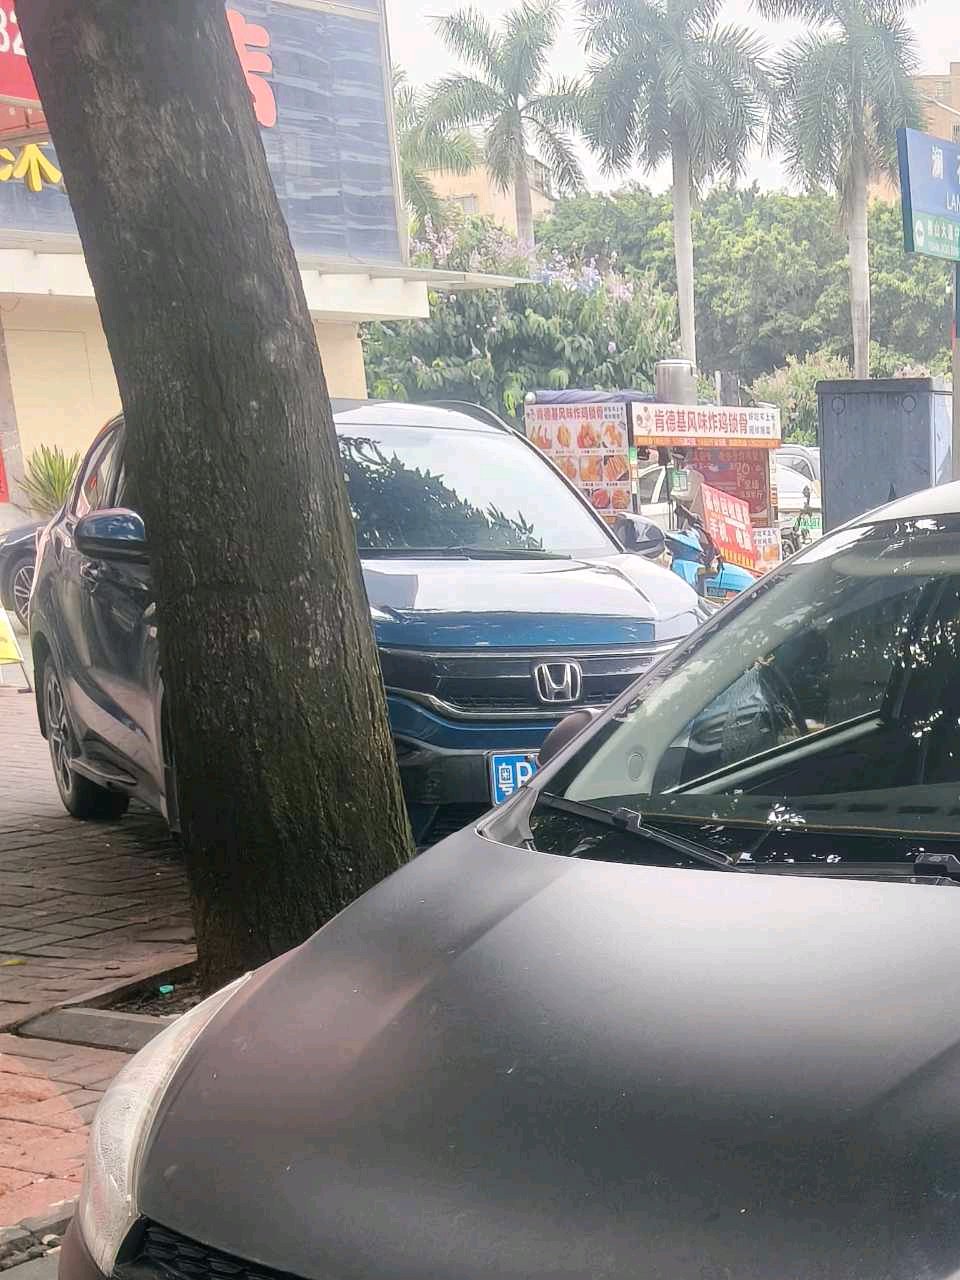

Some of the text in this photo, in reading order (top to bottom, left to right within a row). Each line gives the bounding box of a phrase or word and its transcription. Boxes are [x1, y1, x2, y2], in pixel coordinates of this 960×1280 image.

[655, 409, 748, 434] 肯德基风味炸鸡锁骨
